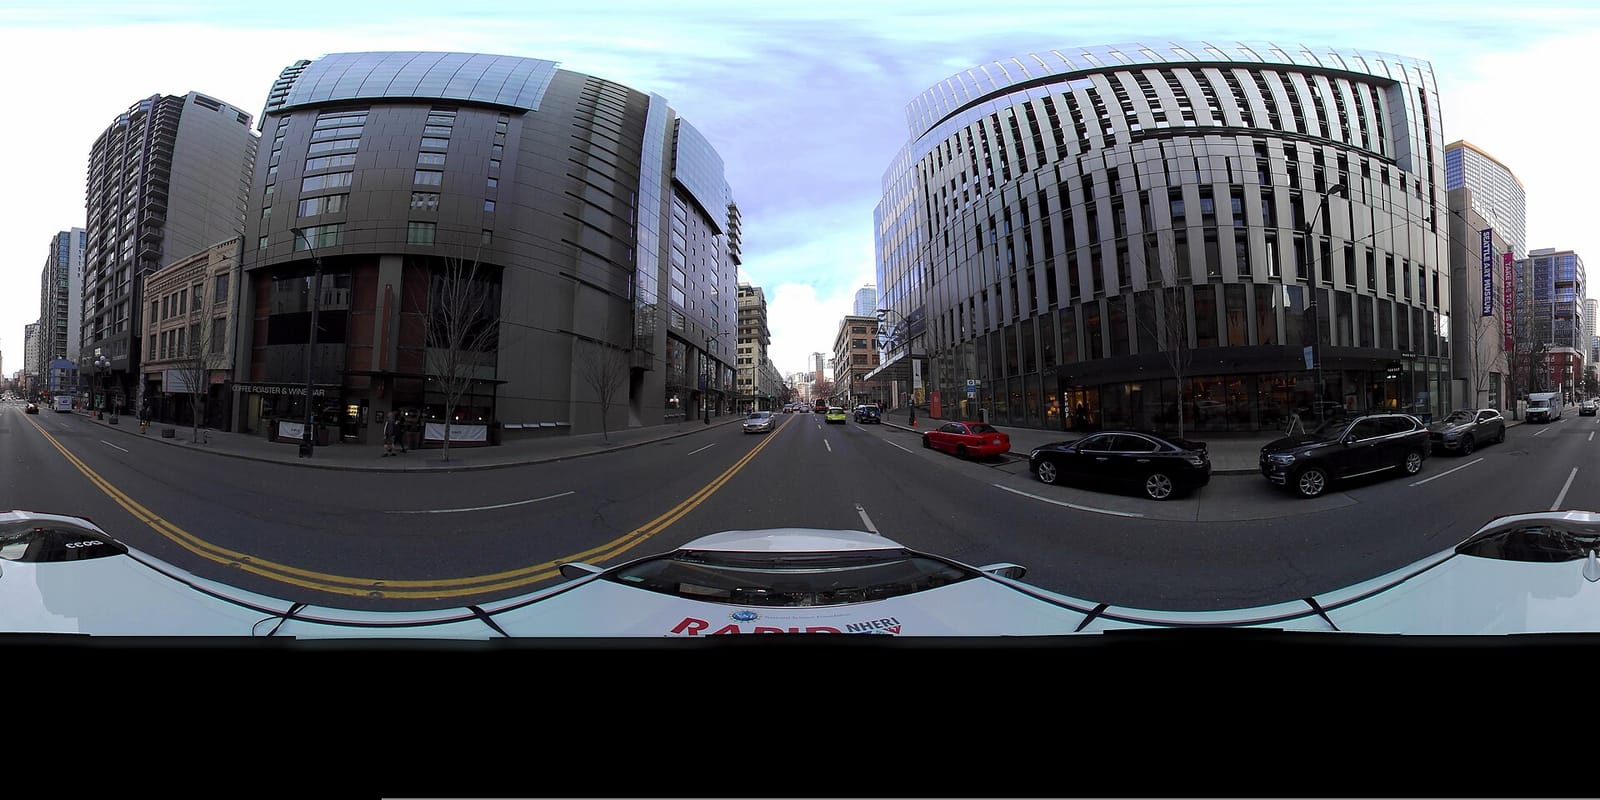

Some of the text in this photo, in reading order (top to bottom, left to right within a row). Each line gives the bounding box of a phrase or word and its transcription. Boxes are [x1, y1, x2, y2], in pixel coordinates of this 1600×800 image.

[1483, 262, 1491, 279] ART
[1483, 279, 1491, 314] MUSEUM
[1505, 293, 1513, 304] TO
[232, 385, 252, 393] COFFEE
[252, 386, 281, 394] ROASTER
[288, 388, 307, 396] WINE
[846, 617, 900, 632] NHERI
